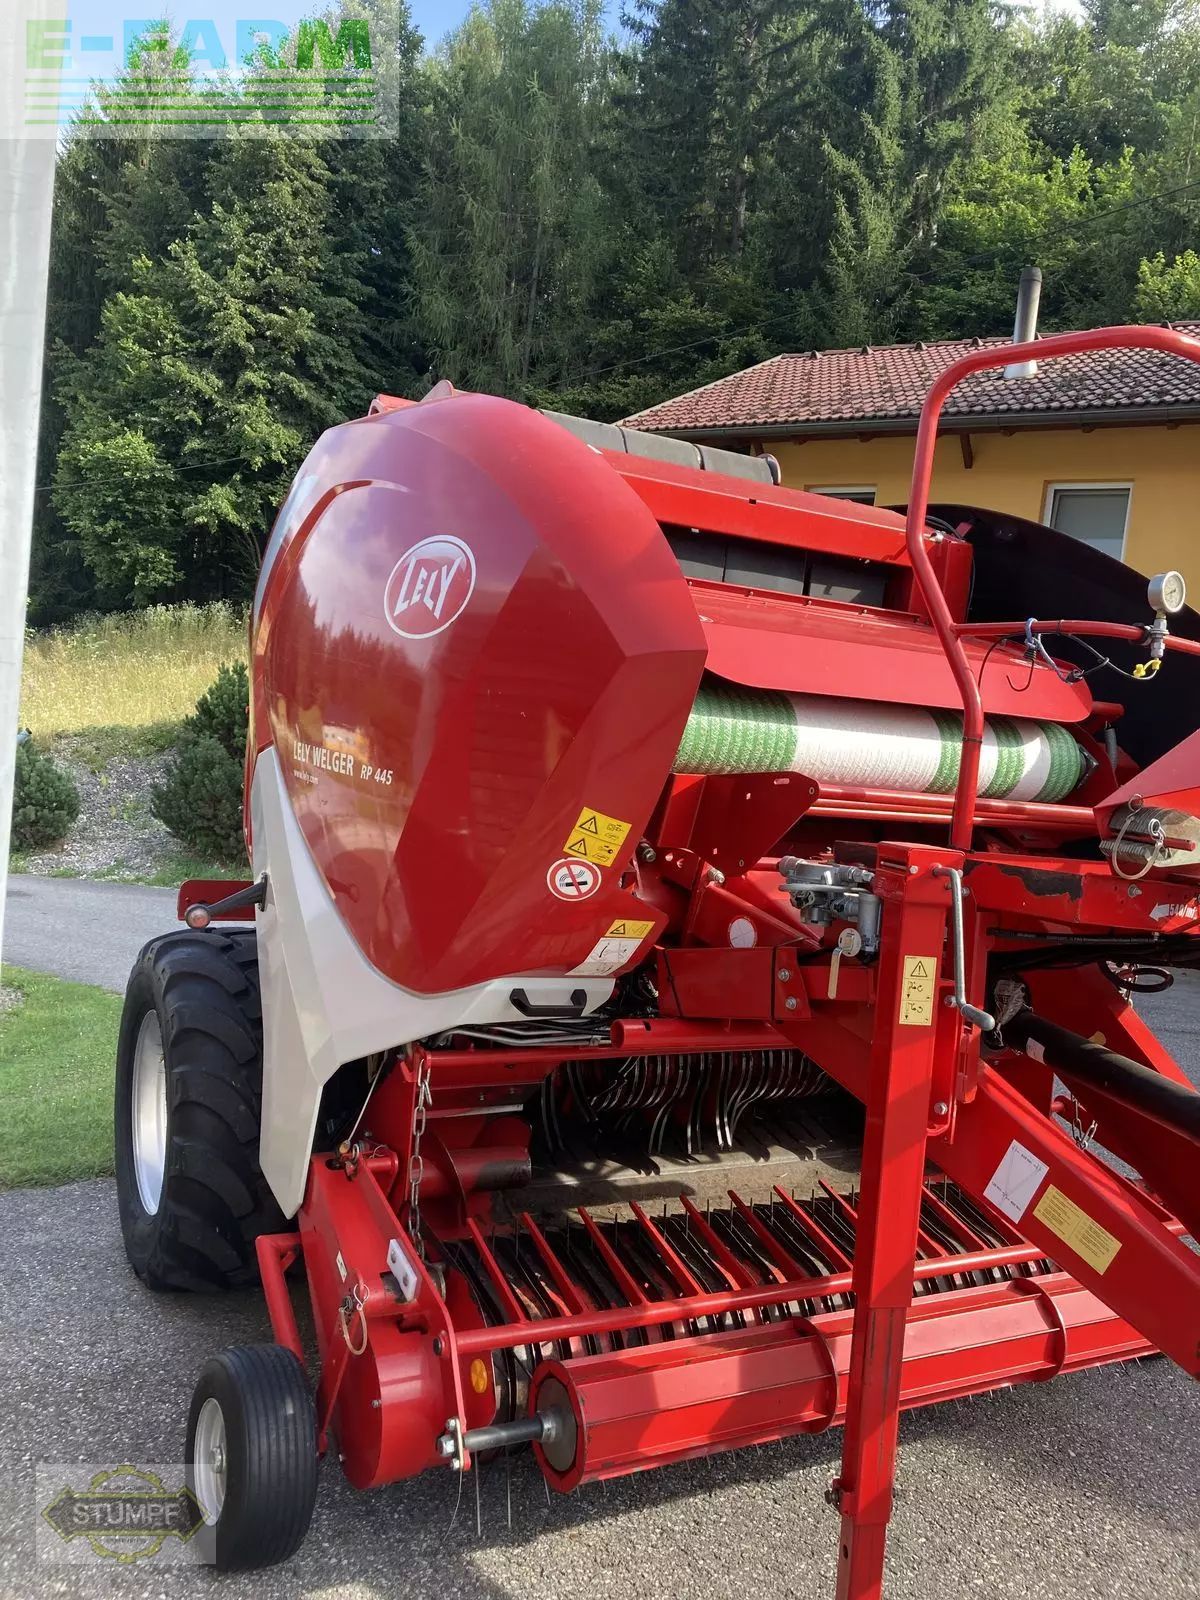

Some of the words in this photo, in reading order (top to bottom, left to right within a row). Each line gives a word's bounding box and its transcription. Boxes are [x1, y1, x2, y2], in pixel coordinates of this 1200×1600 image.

[393, 556, 463, 620] LELY
[293, 740, 311, 764] LELY
[312, 746, 354, 776] WELGER
[361, 765, 373, 780] RP
[374, 768, 394, 785] 445
